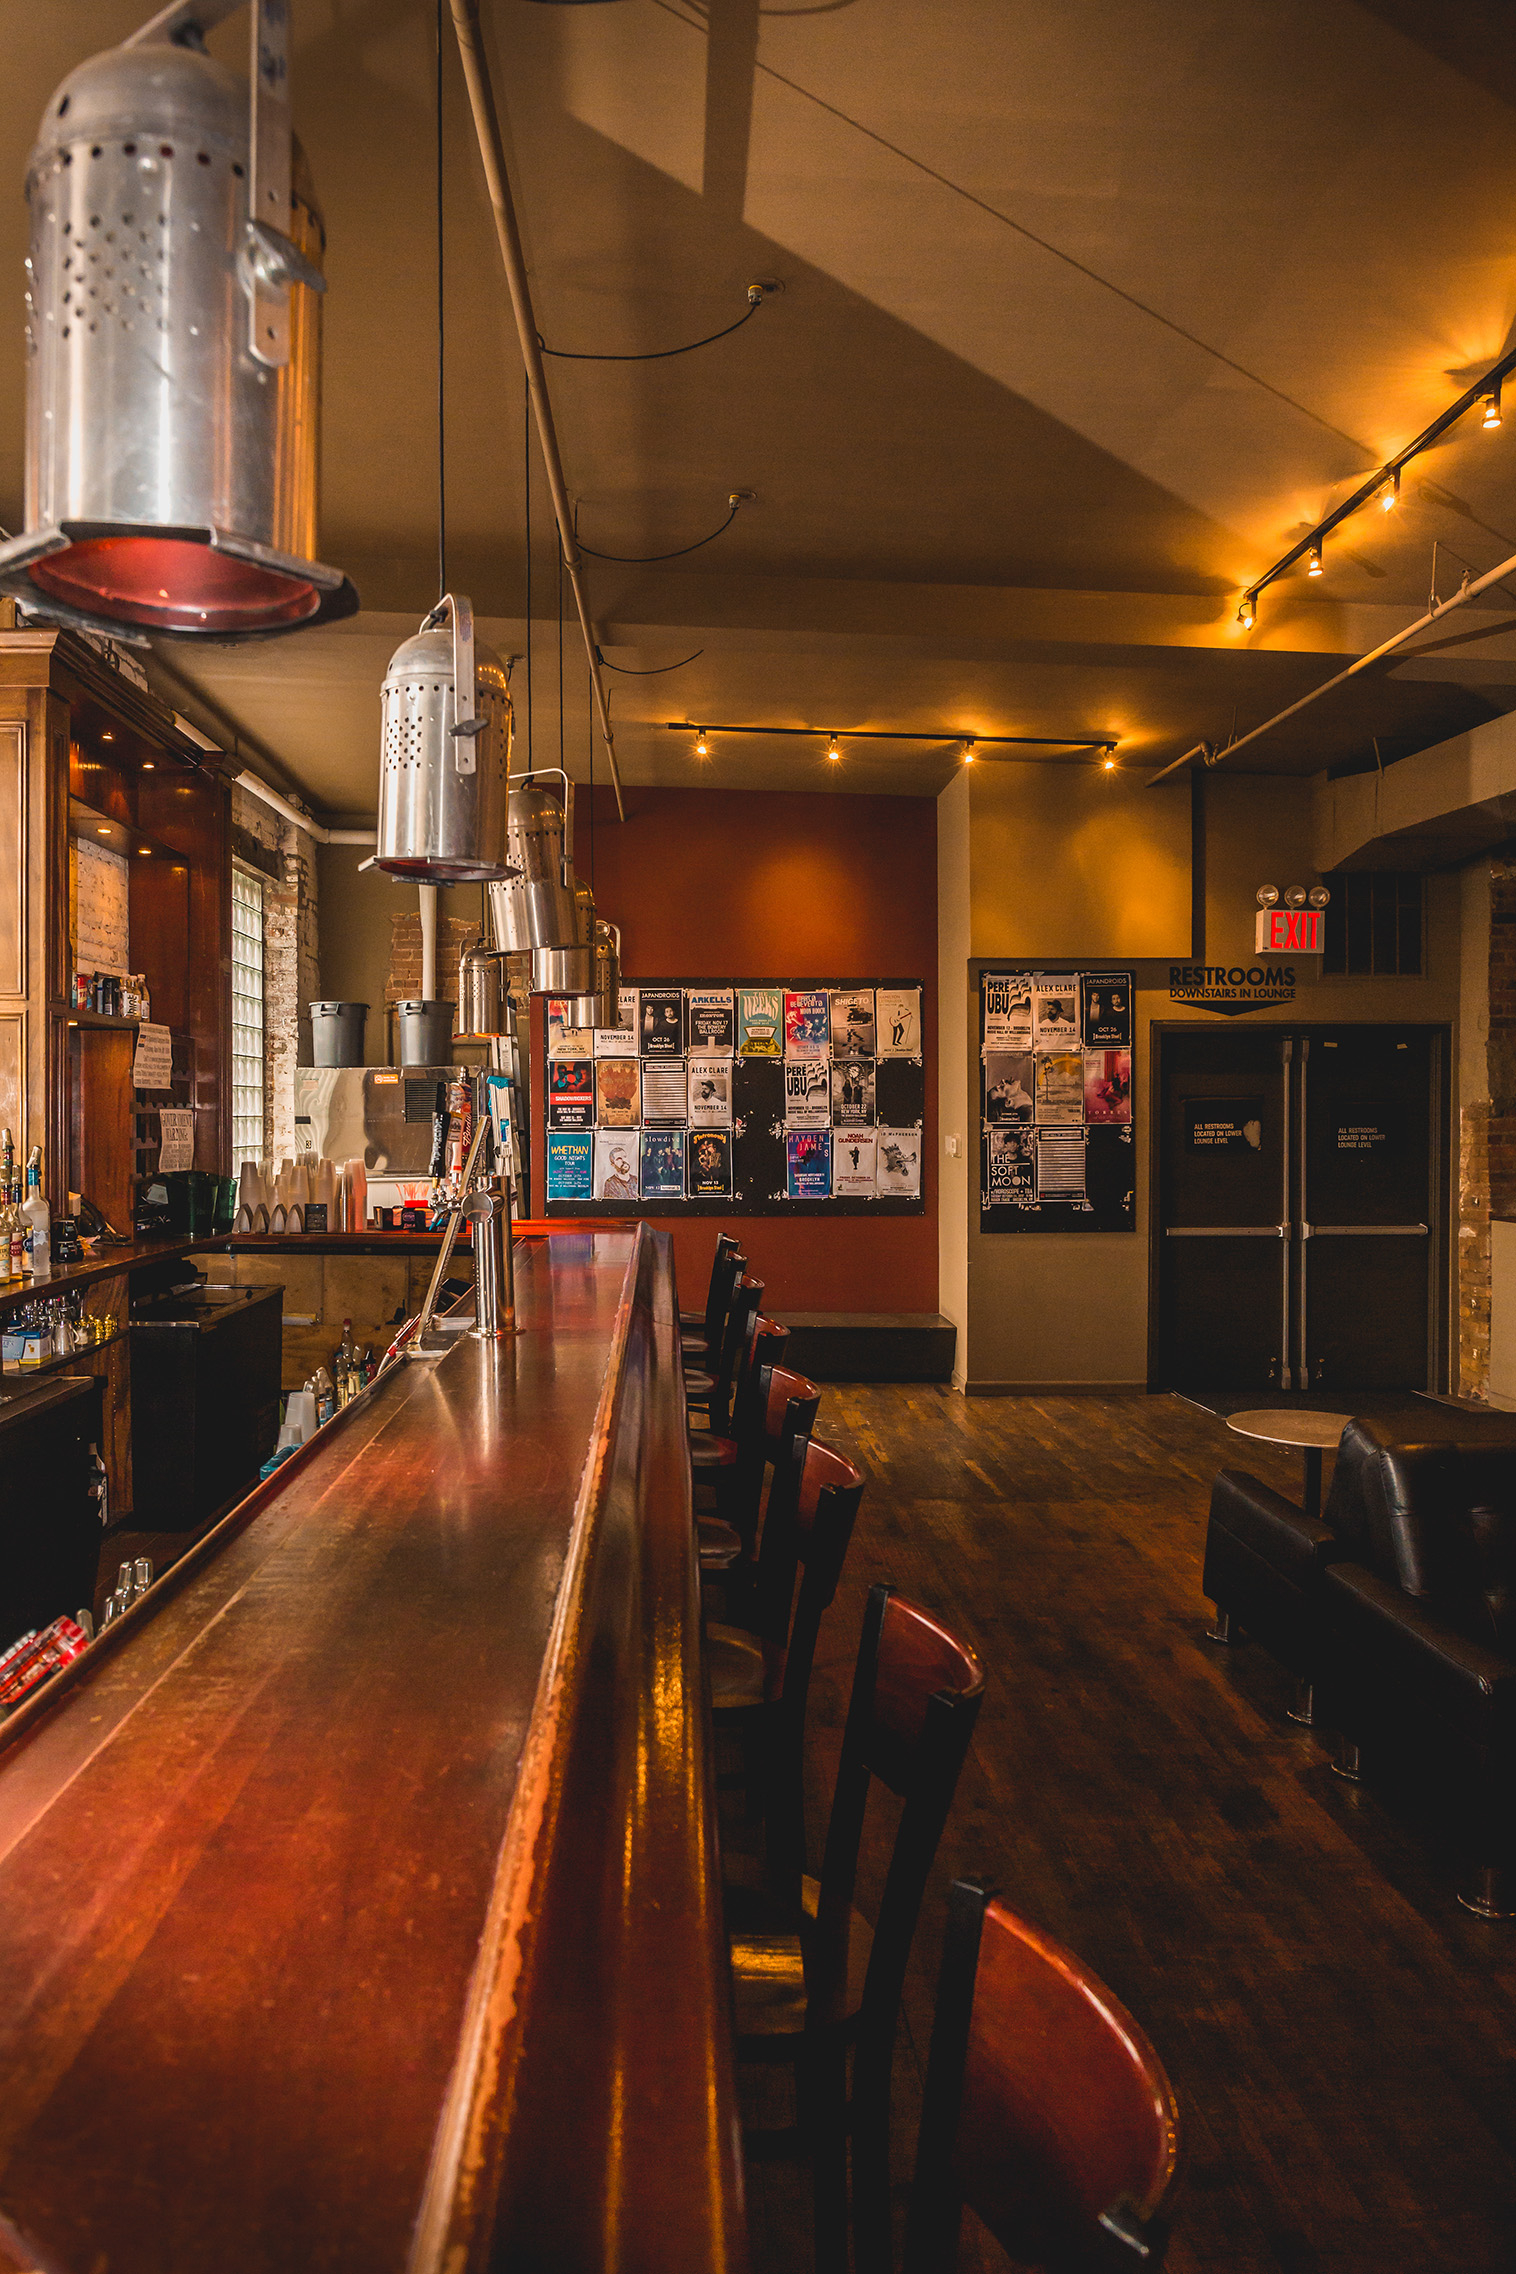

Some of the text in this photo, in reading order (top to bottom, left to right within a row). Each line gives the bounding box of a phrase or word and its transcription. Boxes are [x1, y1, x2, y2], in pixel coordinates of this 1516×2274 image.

[1271, 912, 1320, 949] EXIT
[1169, 967, 1296, 986] RESTROOMS
[1170, 989, 1296, 998] DOWNSTAIRS IN LOUNGE
[834, 998, 869, 1006] SHIGETO
[987, 994, 1009, 1014] UBU
[742, 996, 778, 1021] WEEKS
[787, 1077, 806, 1096] UBU
[551, 1146, 588, 1155] WHETHAN
[992, 1154, 1010, 1164] THE
[991, 1166, 1019, 1176] SOFT
[992, 1176, 1030, 1186] MOON
